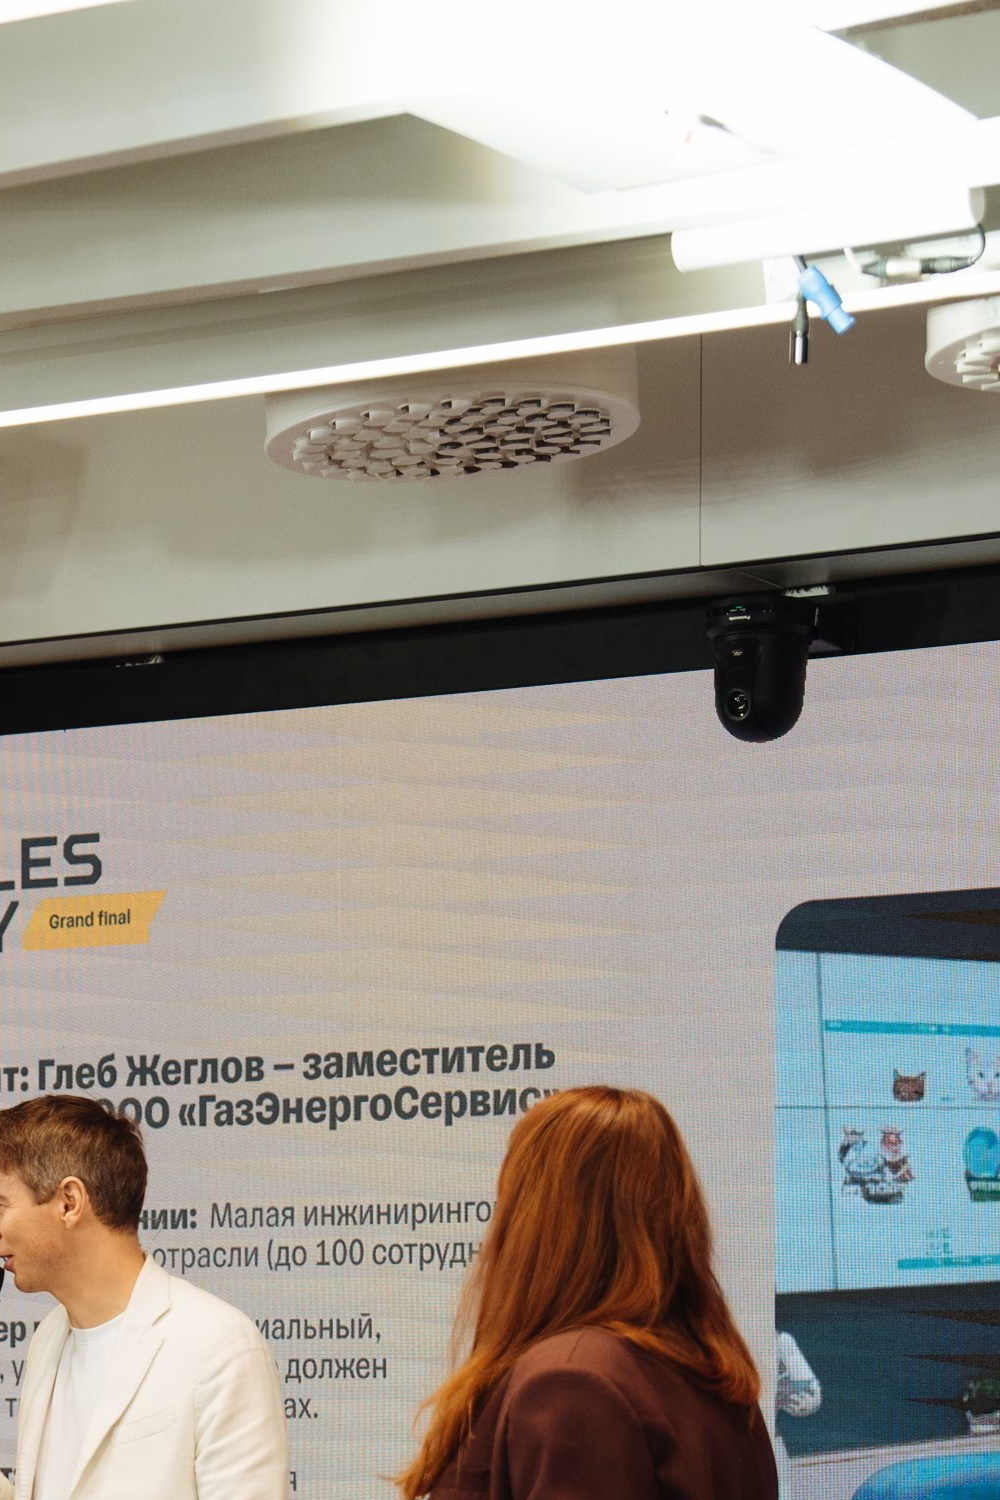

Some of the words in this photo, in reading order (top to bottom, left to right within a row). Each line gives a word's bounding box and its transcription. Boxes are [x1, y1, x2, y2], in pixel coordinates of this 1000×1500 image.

[49, 911, 94, 929] Grand
[98, 909, 131, 926] final
[38, 1053, 117, 1090] Глеб
[126, 1054, 265, 1087] Жеглов
[302, 1042, 556, 1080] заместитель
[210, 1202, 295, 1228] Малая
[303, 1200, 496, 1231] инжиниринго
[153, 1246, 259, 1275] отрасли
[267, 1239, 307, 1271] (до
[316, 1239, 364, 1266] 100
[285, 1357, 387, 1383] должен
